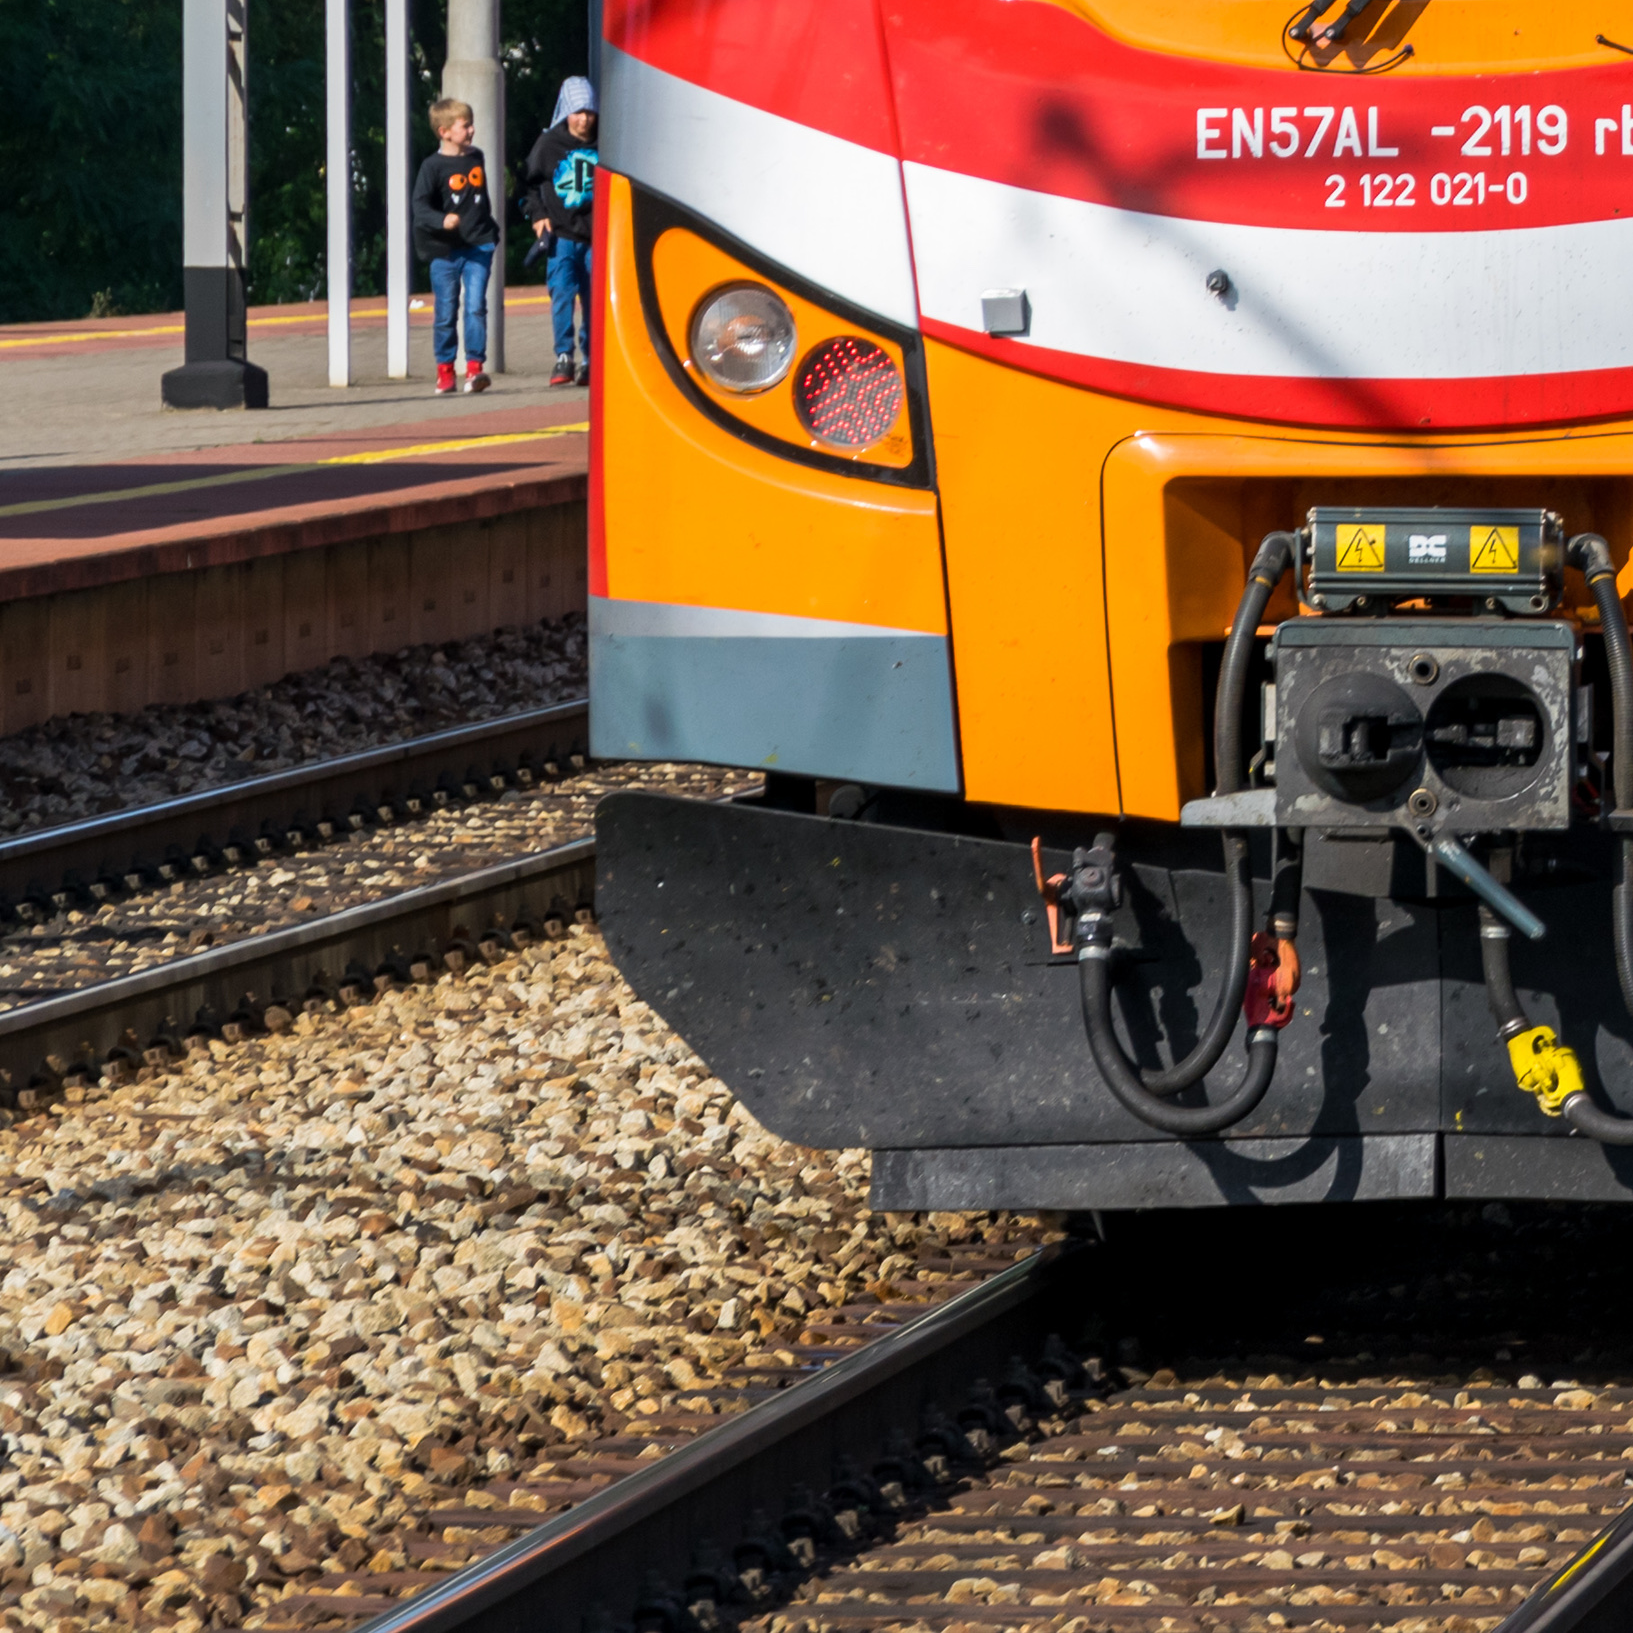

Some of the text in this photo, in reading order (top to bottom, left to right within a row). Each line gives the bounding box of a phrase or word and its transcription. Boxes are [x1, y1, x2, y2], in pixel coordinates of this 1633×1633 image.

[1195, 104, 1400, 160] EN57AL
[1324, 171, 1528, 208] 2 122 021-0
